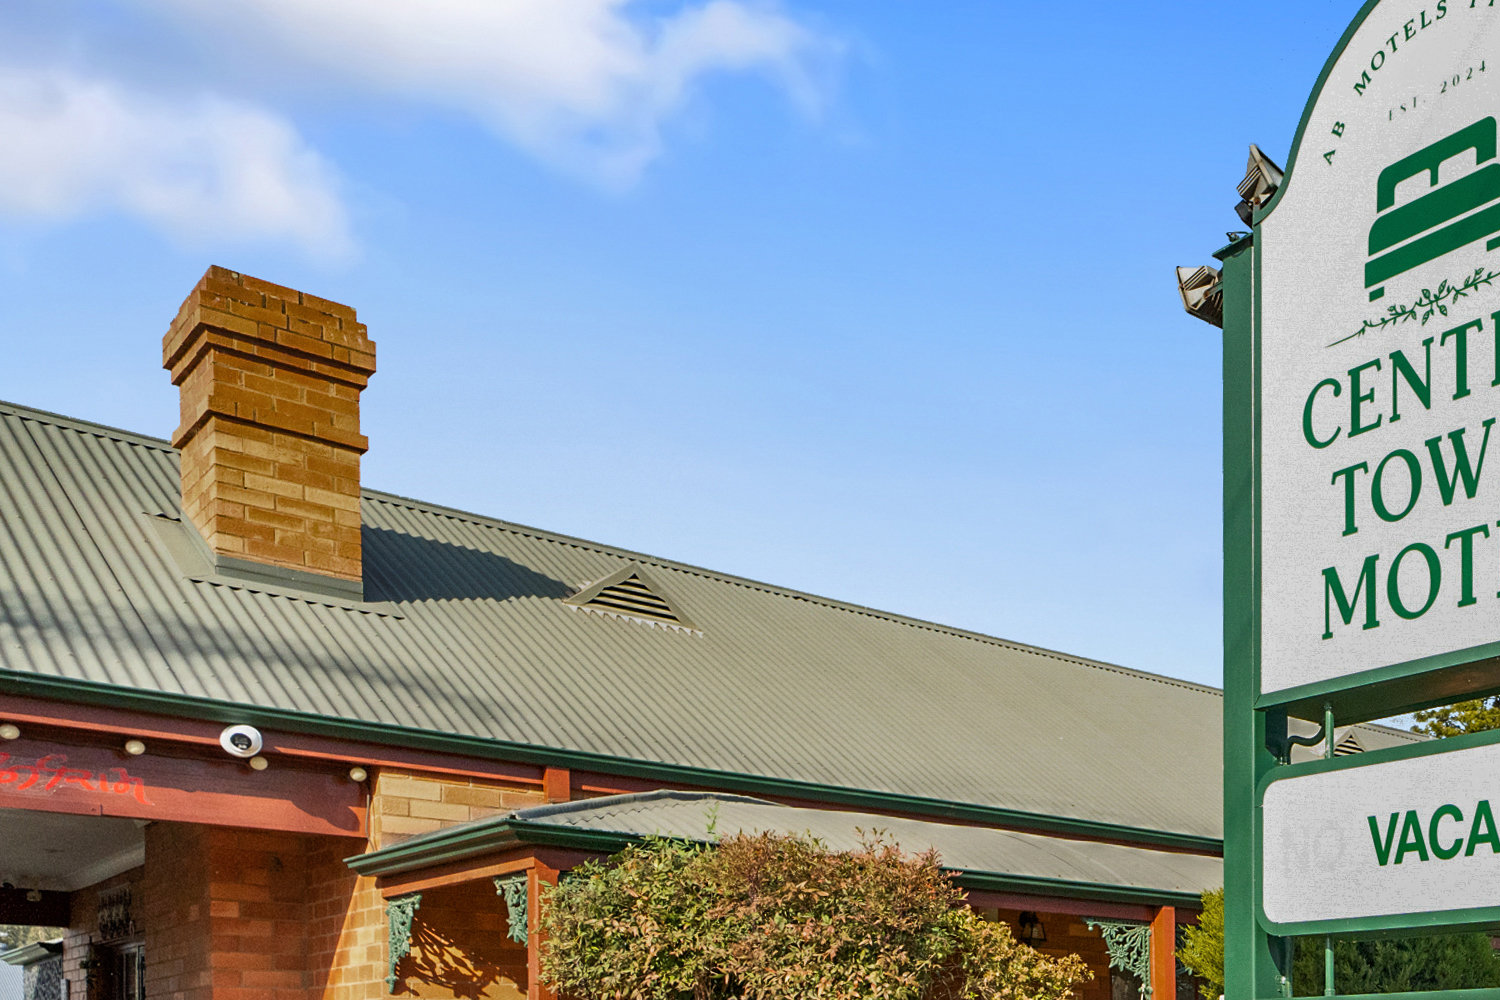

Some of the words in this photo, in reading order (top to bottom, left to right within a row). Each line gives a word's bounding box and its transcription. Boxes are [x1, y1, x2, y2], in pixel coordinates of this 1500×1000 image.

[1323, 121, 1346, 165] AB
[1353, 0, 1447, 97] MOTELS
[1440, 59, 1487, 95] 2024
